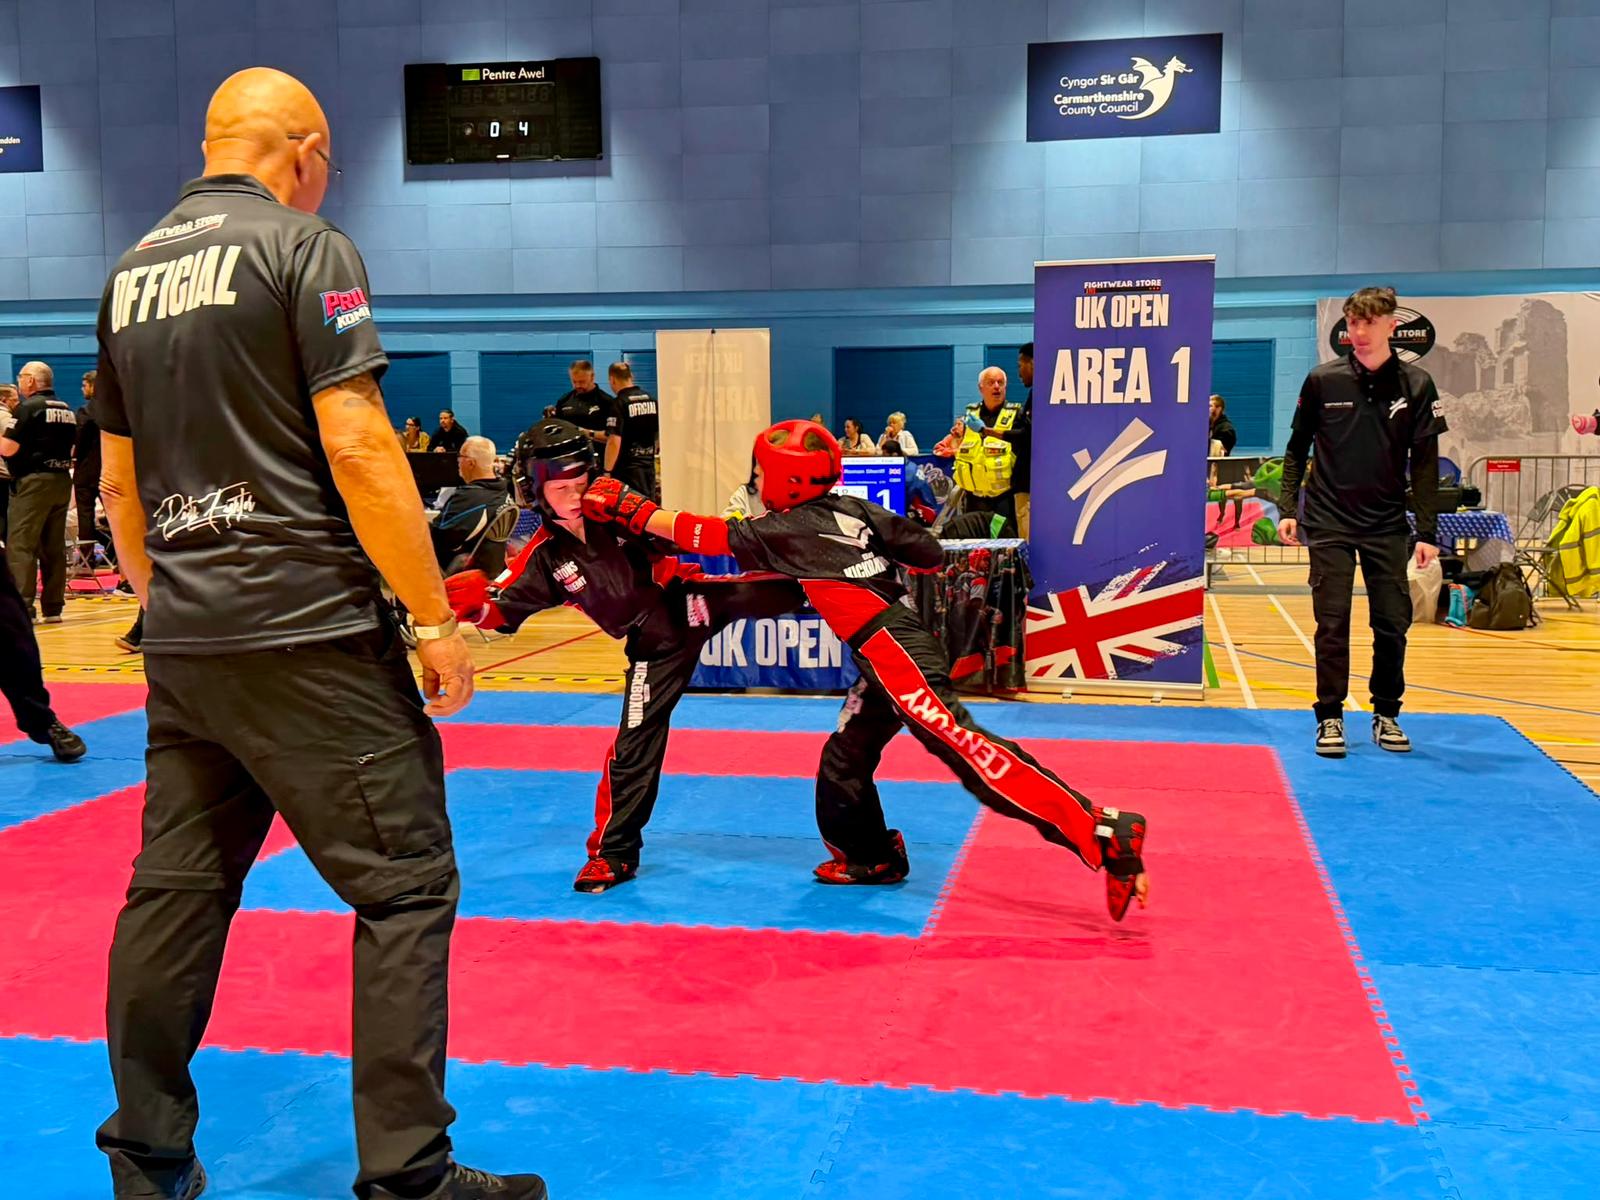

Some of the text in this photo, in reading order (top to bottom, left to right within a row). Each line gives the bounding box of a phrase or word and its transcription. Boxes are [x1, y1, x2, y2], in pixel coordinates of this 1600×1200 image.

[482, 66, 545, 81] Pentre Awel
[1060, 76, 1098, 89] Cyngor
[1100, 74, 1116, 86] Sir
[1053, 90, 1144, 105] Carmarthenshire
[1059, 102, 1139, 117] County Council
[489, 121, 529, 138] 0 4
[111, 245, 242, 334] OFFICIAL
[1084, 279, 1162, 289] FIGHTWEAR STORE
[1075, 293, 1170, 329] UK OPEN
[1397, 329, 1427, 338] STORE
[1049, 346, 1191, 405] AREA 1
[700, 618, 842, 668] UK OPEN
[627, 661, 649, 729] KICKBOXING
[899, 687, 1012, 780] CENTURY
